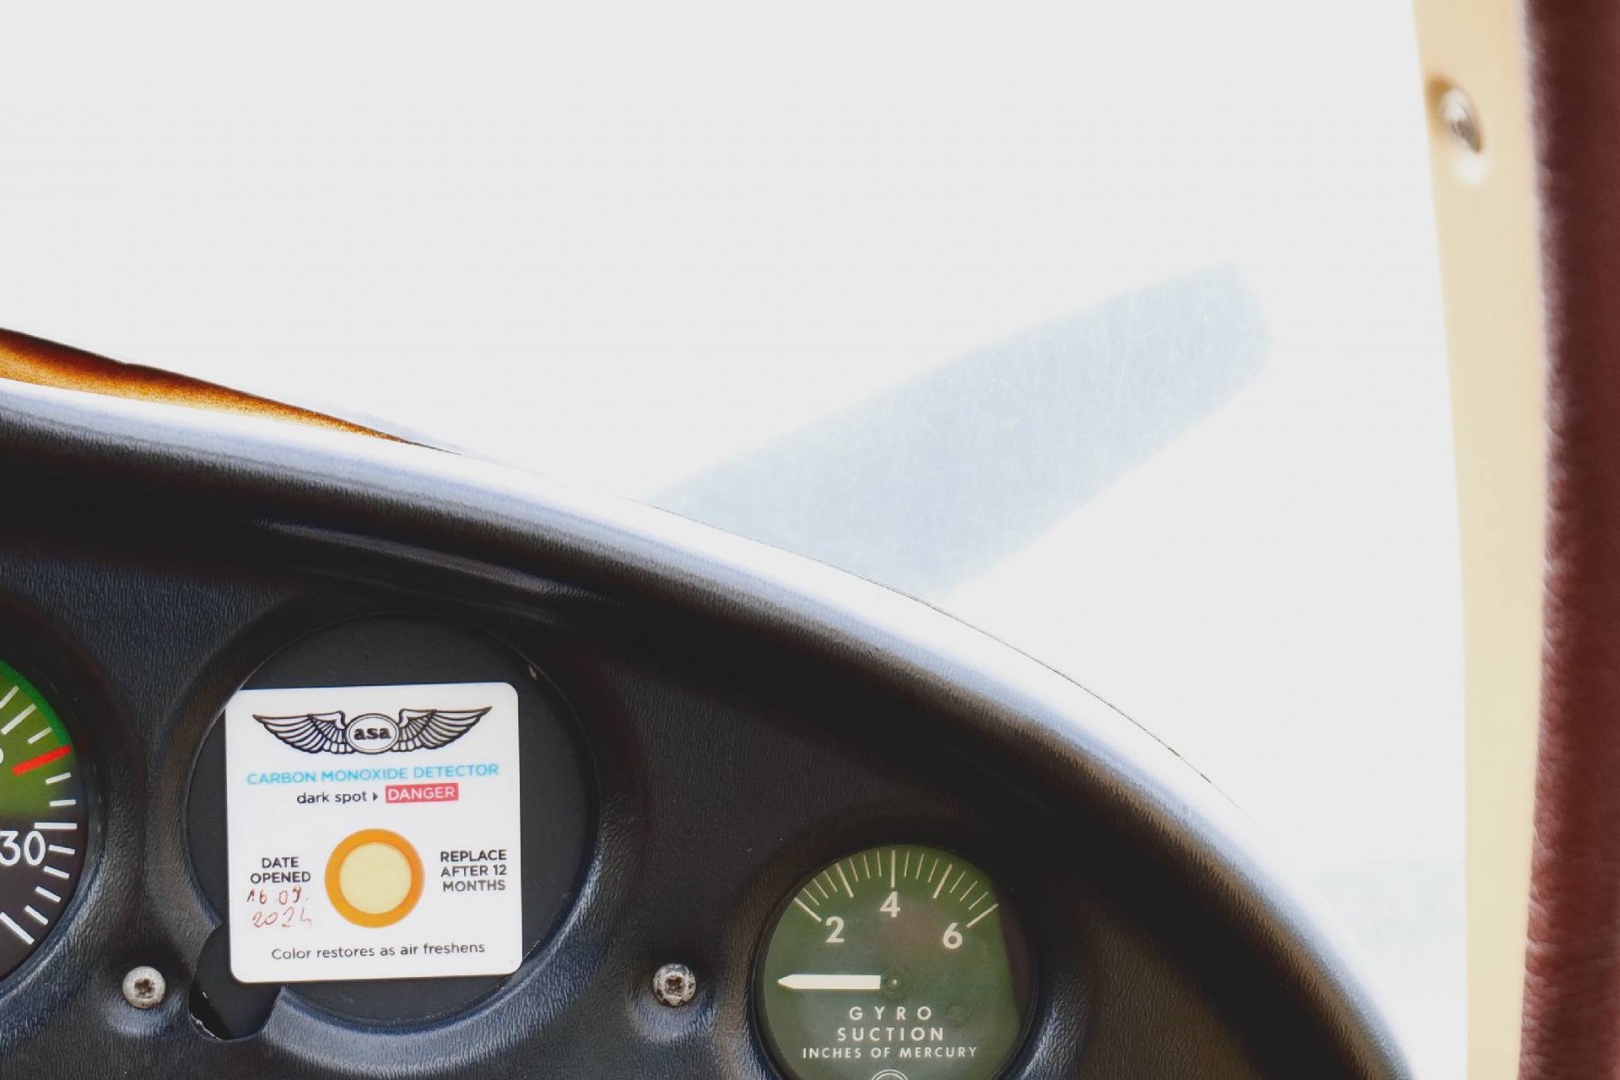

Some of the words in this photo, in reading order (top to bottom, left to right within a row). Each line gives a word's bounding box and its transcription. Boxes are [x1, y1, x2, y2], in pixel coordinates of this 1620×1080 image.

[246, 771, 317, 785] CARBON
[321, 767, 409, 783] MONOXIDE
[413, 763, 499, 779] DETECTOR
[297, 792, 330, 804] dark
[334, 791, 367, 805] spot
[387, 786, 456, 801] DANGER
[261, 857, 299, 869] DATE
[440, 850, 507, 863] REPLACE
[250, 871, 311, 885] OPENED
[440, 865, 489, 878] AFTER
[493, 864, 507, 876] 12
[442, 880, 506, 892] MONTHS
[271, 947, 311, 961] Color
[316, 945, 375, 959] restores
[380, 947, 395, 957] as
[400, 943, 418, 956] air
[423, 942, 485, 955] freshens
[849, 1006, 932, 1021] GYRO
[837, 1027, 944, 1042] SUCTION
[803, 1047, 861, 1059] INCHES
[871, 1047, 891, 1059] OF
[900, 1046, 977, 1059] MERCURY
